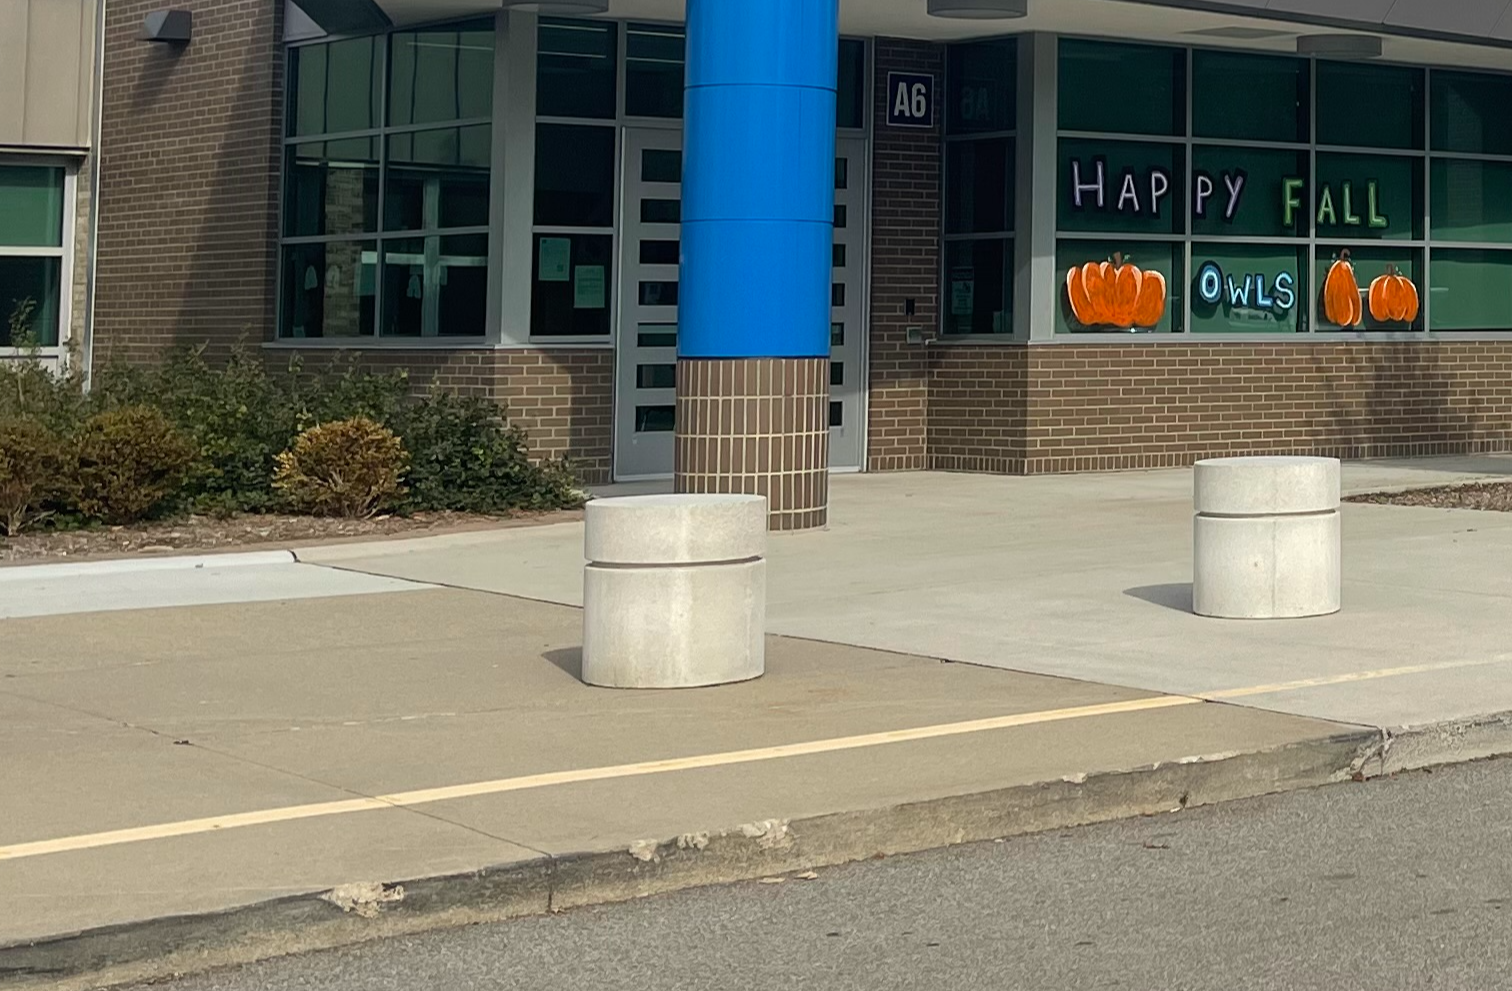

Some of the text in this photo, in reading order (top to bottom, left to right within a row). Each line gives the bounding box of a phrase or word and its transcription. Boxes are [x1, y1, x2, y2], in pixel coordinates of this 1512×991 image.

[893, 81, 927, 118] A6
[1071, 160, 1389, 228] HAPPY FALL
[1199, 264, 1296, 310] OWLS
